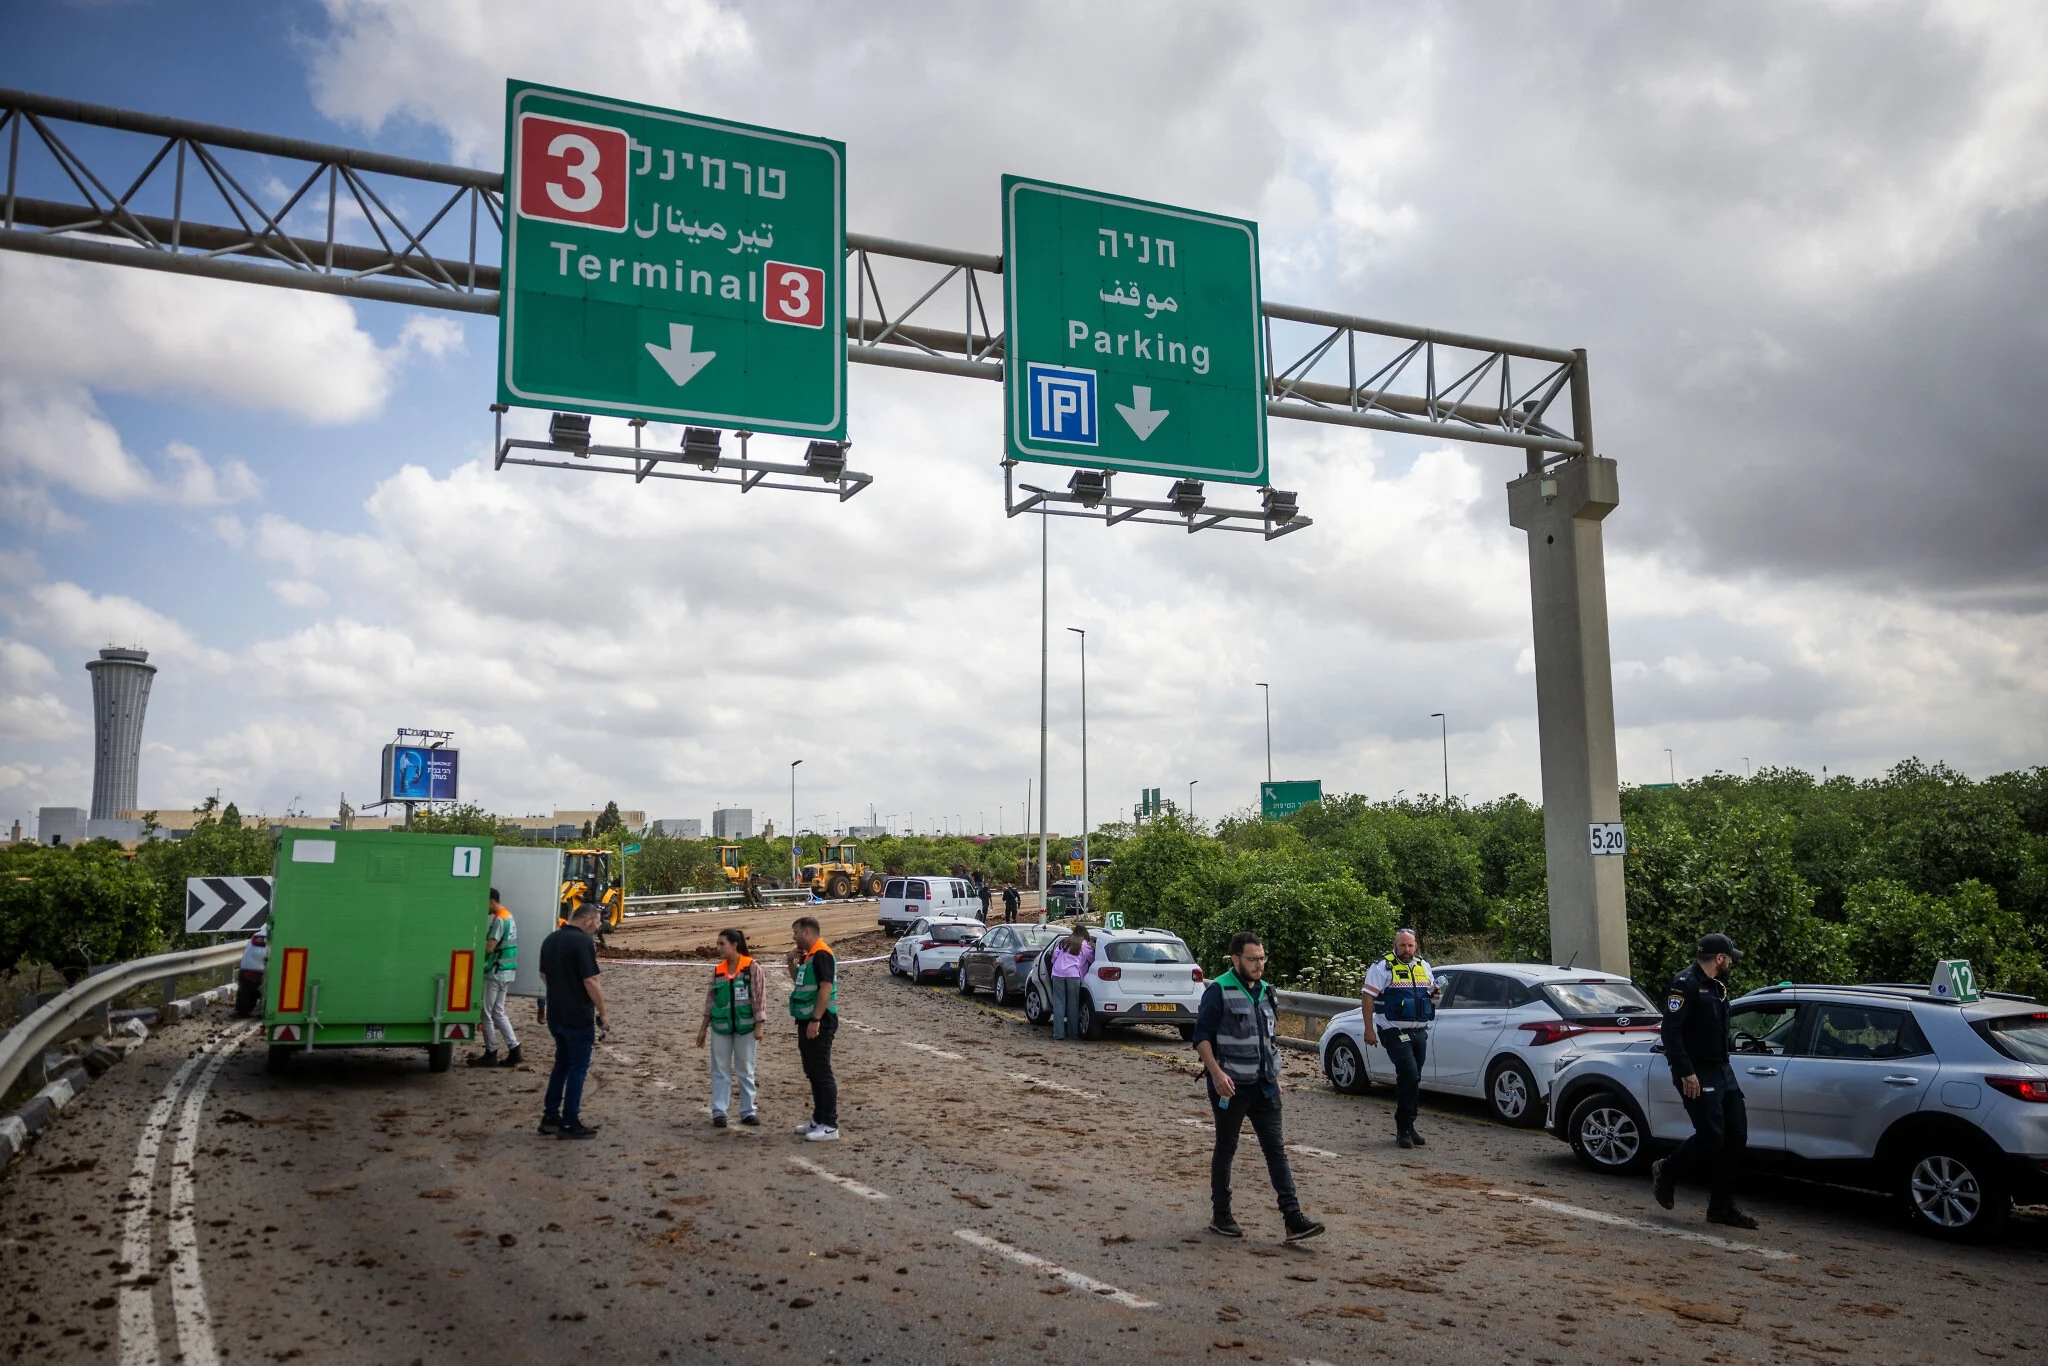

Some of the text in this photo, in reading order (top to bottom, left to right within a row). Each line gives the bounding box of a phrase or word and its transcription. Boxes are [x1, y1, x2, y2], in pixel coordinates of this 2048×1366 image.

[545, 133, 603, 213] 3
[629, 137, 786, 200] טרמינל
[633, 202, 774, 255] تيرمينال
[1098, 228, 1176, 268] חניה
[550, 241, 811, 318] Terminal 3
[1099, 279, 1178, 319] موقف
[1068, 319, 1210, 375] Parking
[1052, 389, 1077, 433] P
[1592, 828, 1623, 849] 5.20
[464, 850, 471, 873] 1
[1109, 913, 1124, 928] 15
[1951, 966, 1977, 996] 12
